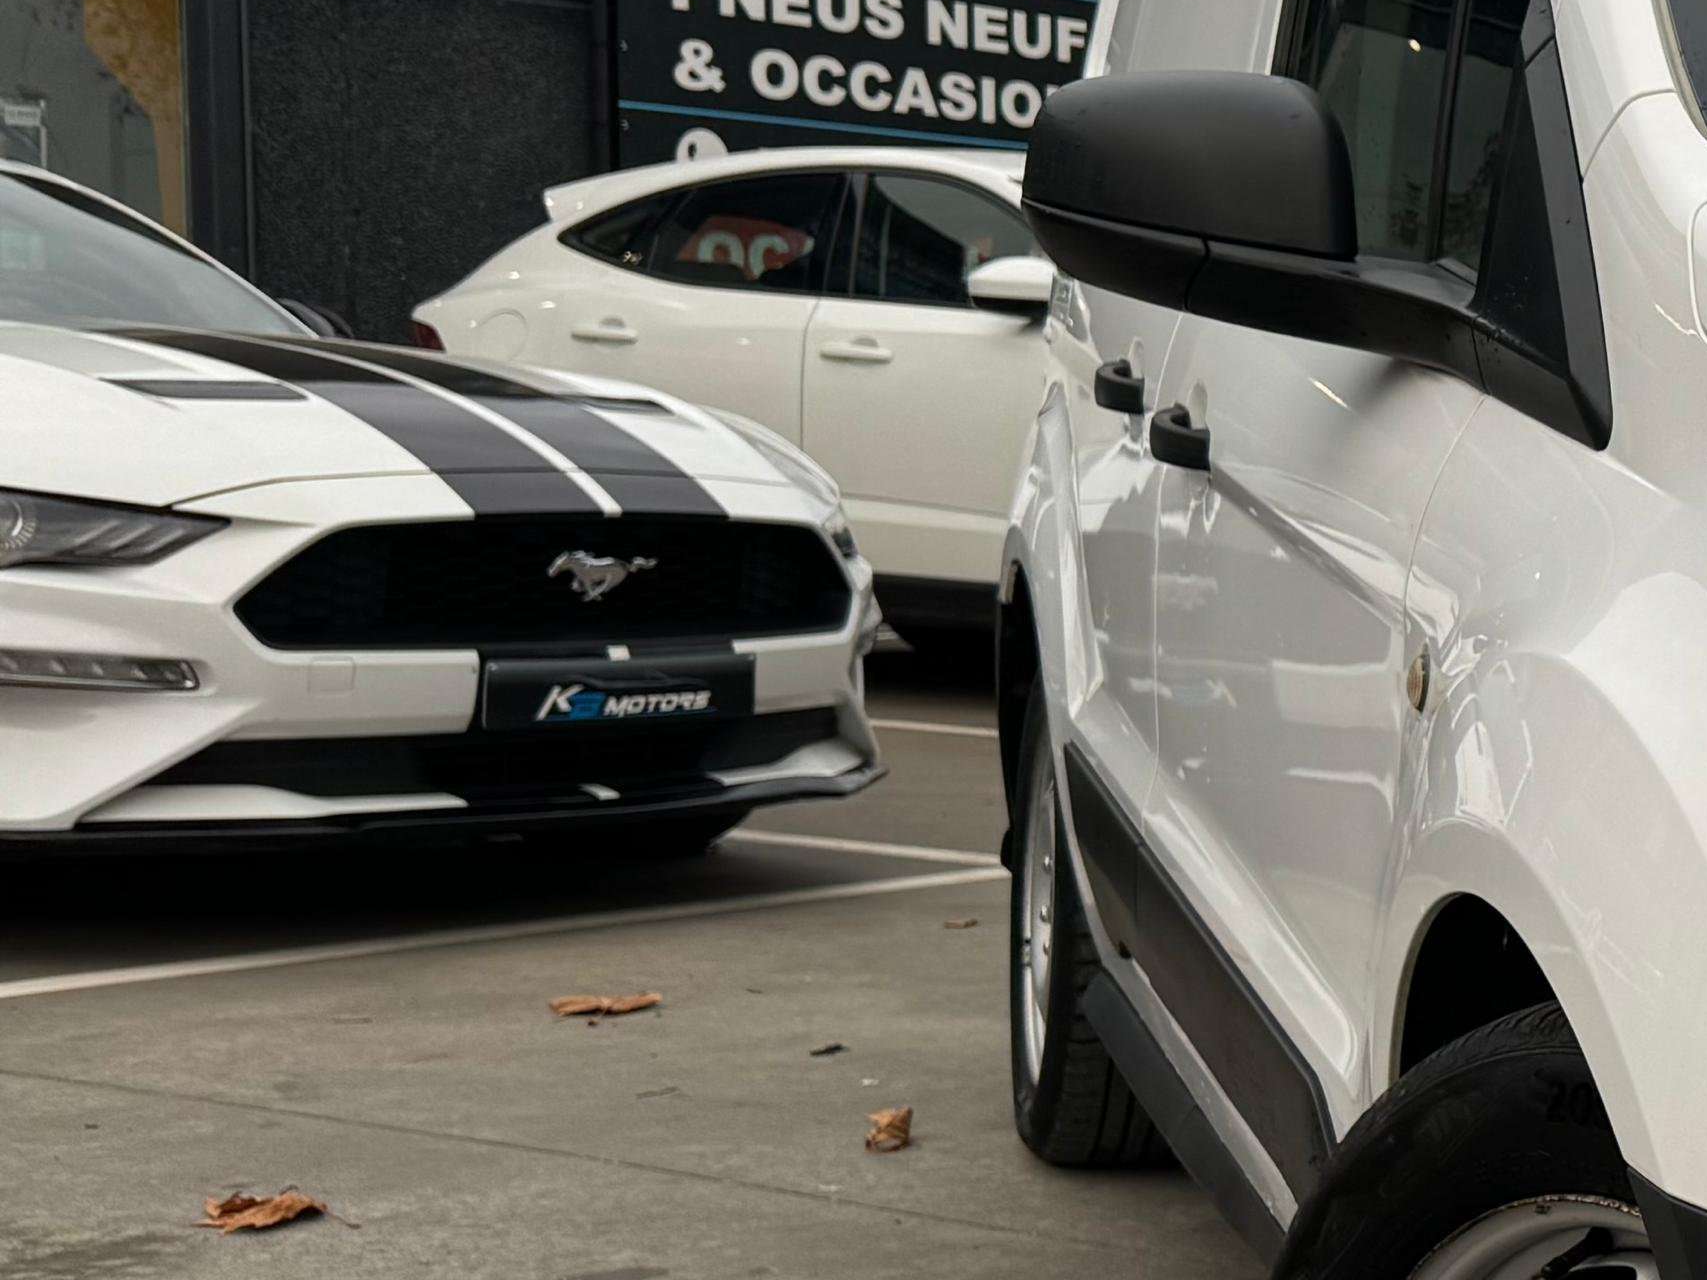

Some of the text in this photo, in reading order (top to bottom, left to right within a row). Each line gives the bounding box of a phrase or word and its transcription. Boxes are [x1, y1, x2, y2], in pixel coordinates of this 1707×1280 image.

[672, 38, 1060, 130] & OCCASIO
[602, 689, 712, 718] MOTORS
